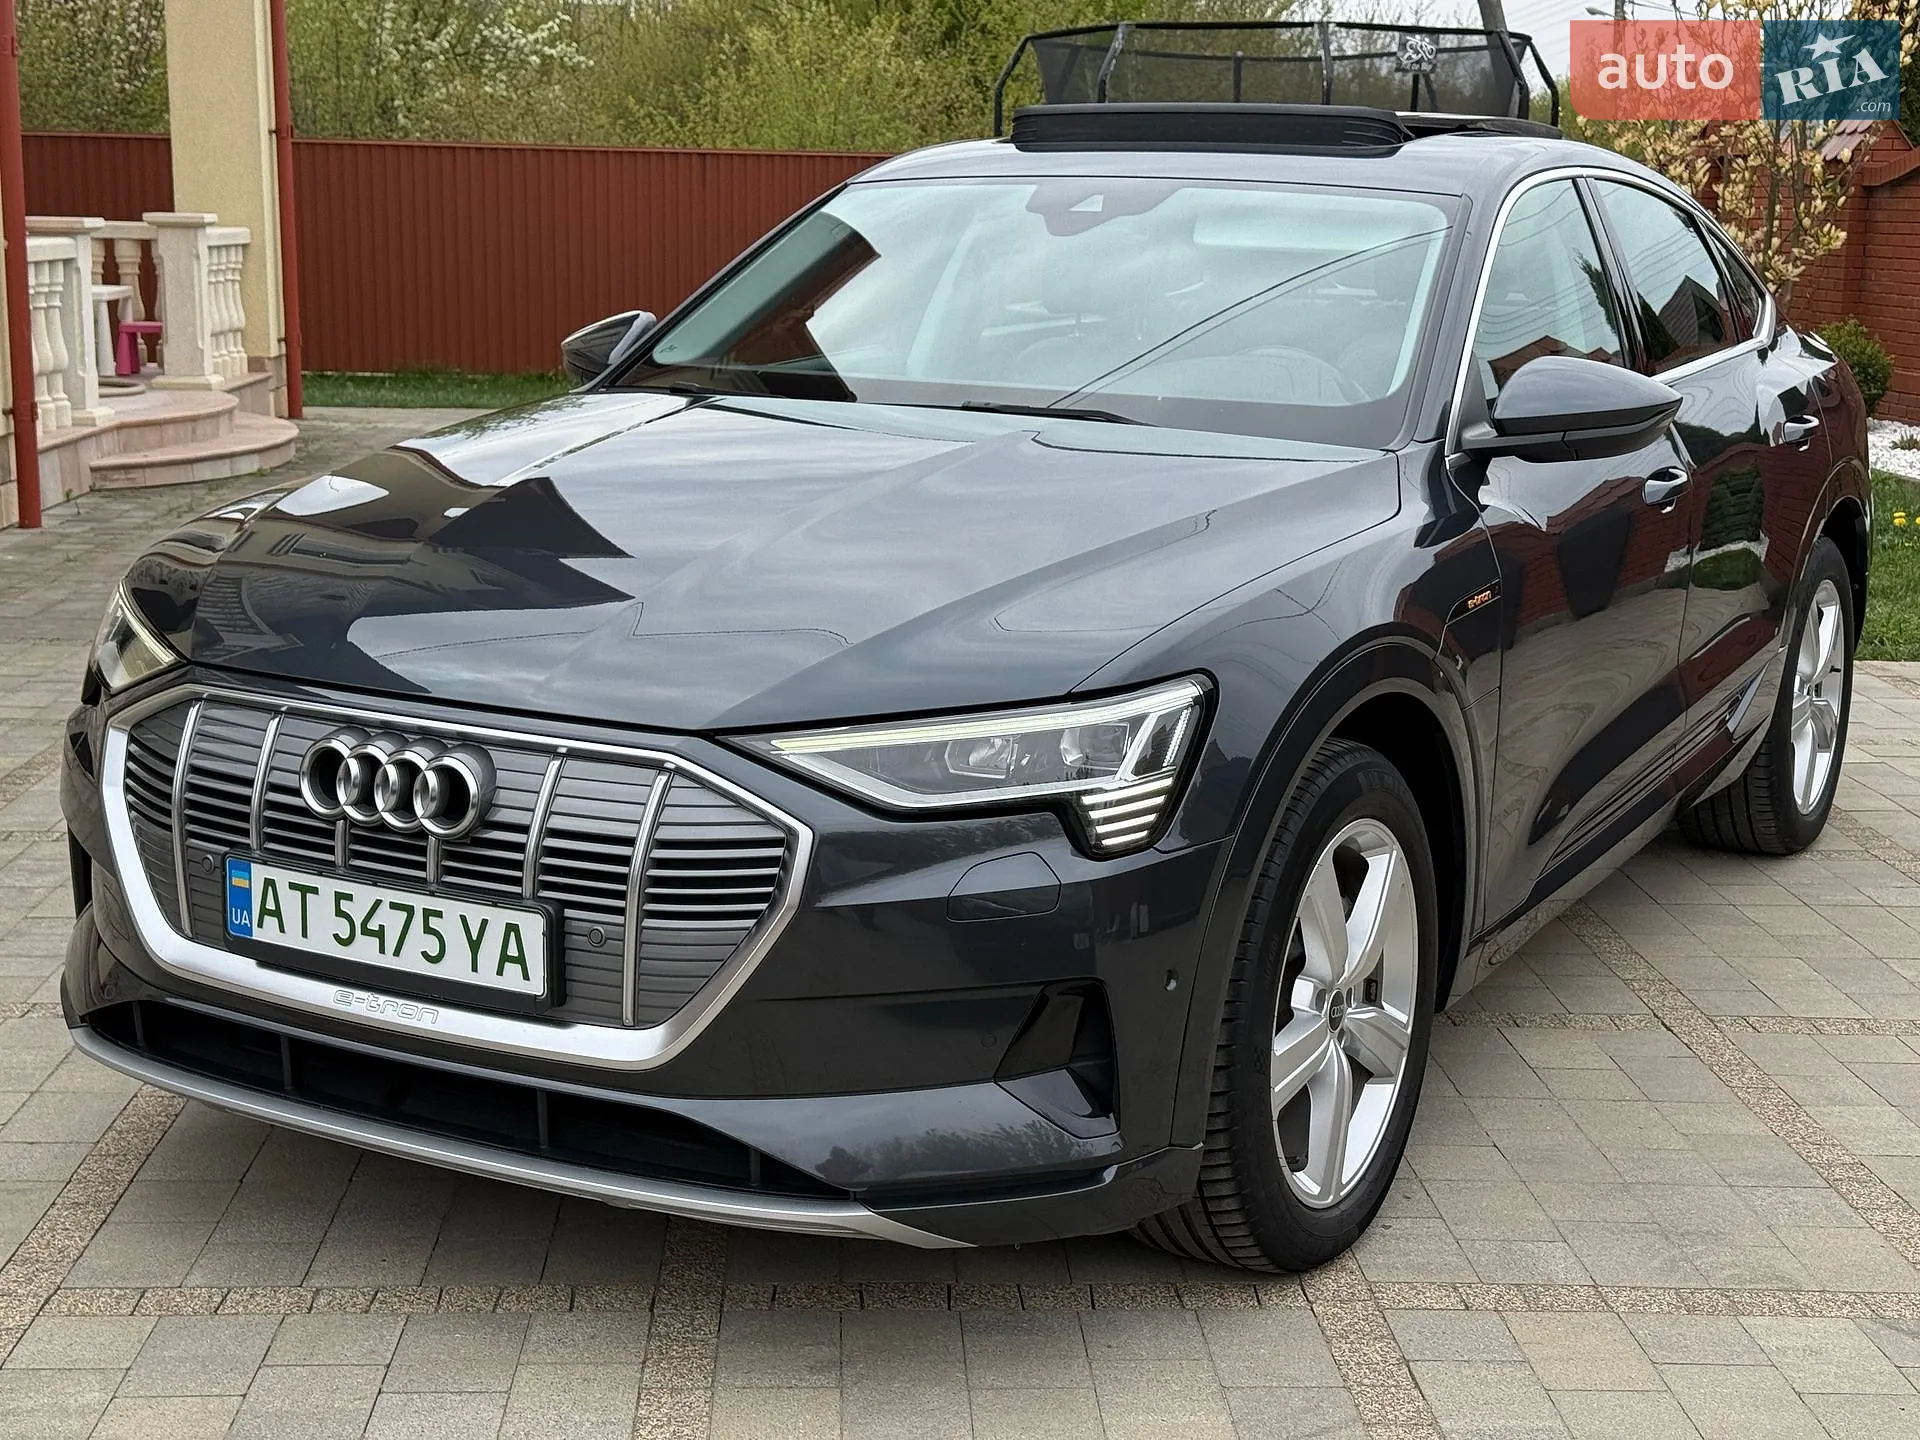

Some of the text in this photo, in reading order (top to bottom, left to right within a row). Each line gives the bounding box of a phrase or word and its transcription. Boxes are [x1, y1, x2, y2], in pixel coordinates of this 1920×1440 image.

[232, 907, 251, 928] UA
[257, 876, 531, 982] AT 5475 YA
[332, 988, 440, 1025] e-tron
